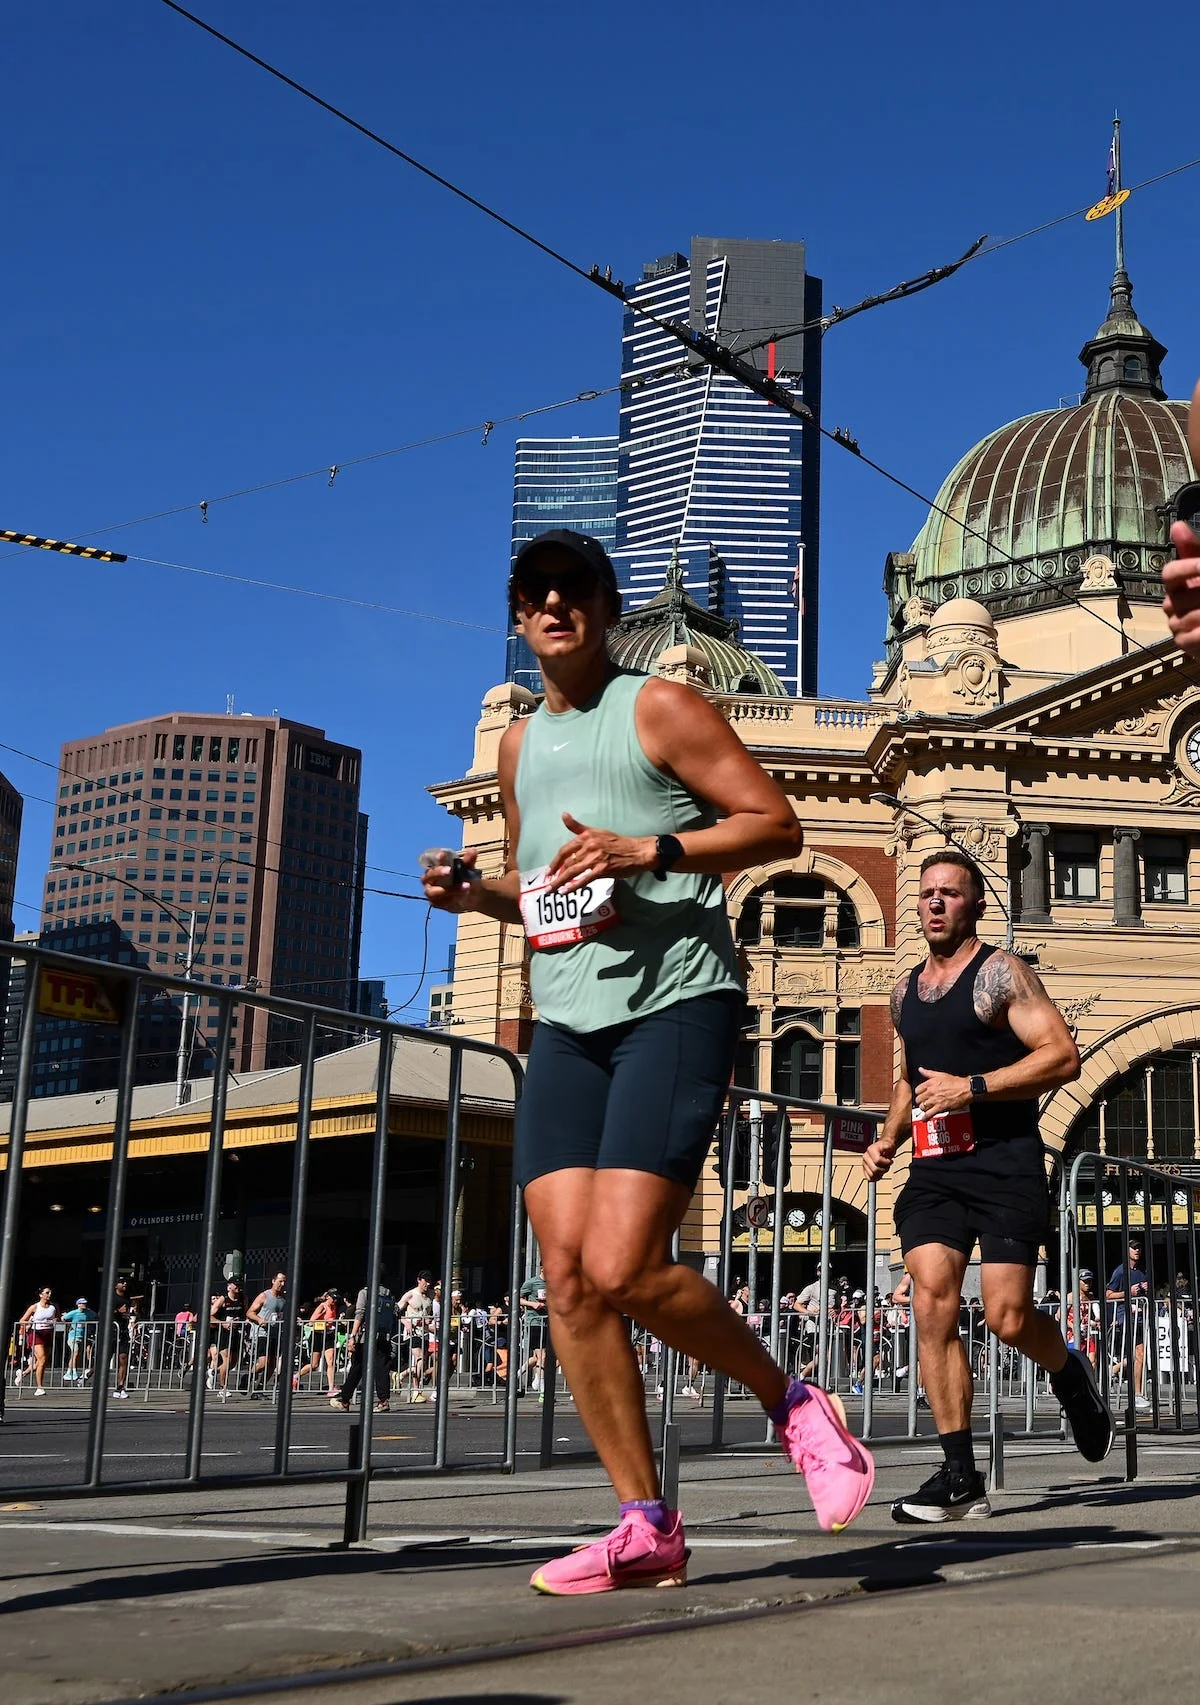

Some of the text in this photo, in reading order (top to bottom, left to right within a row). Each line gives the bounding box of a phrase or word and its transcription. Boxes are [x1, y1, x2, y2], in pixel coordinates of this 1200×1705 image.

[536, 886, 593, 926] 15662
[840, 1119, 865, 1134] PINK
[926, 1120, 946, 1133] GLEN
[139, 1213, 204, 1225] FLINDERS STREET
